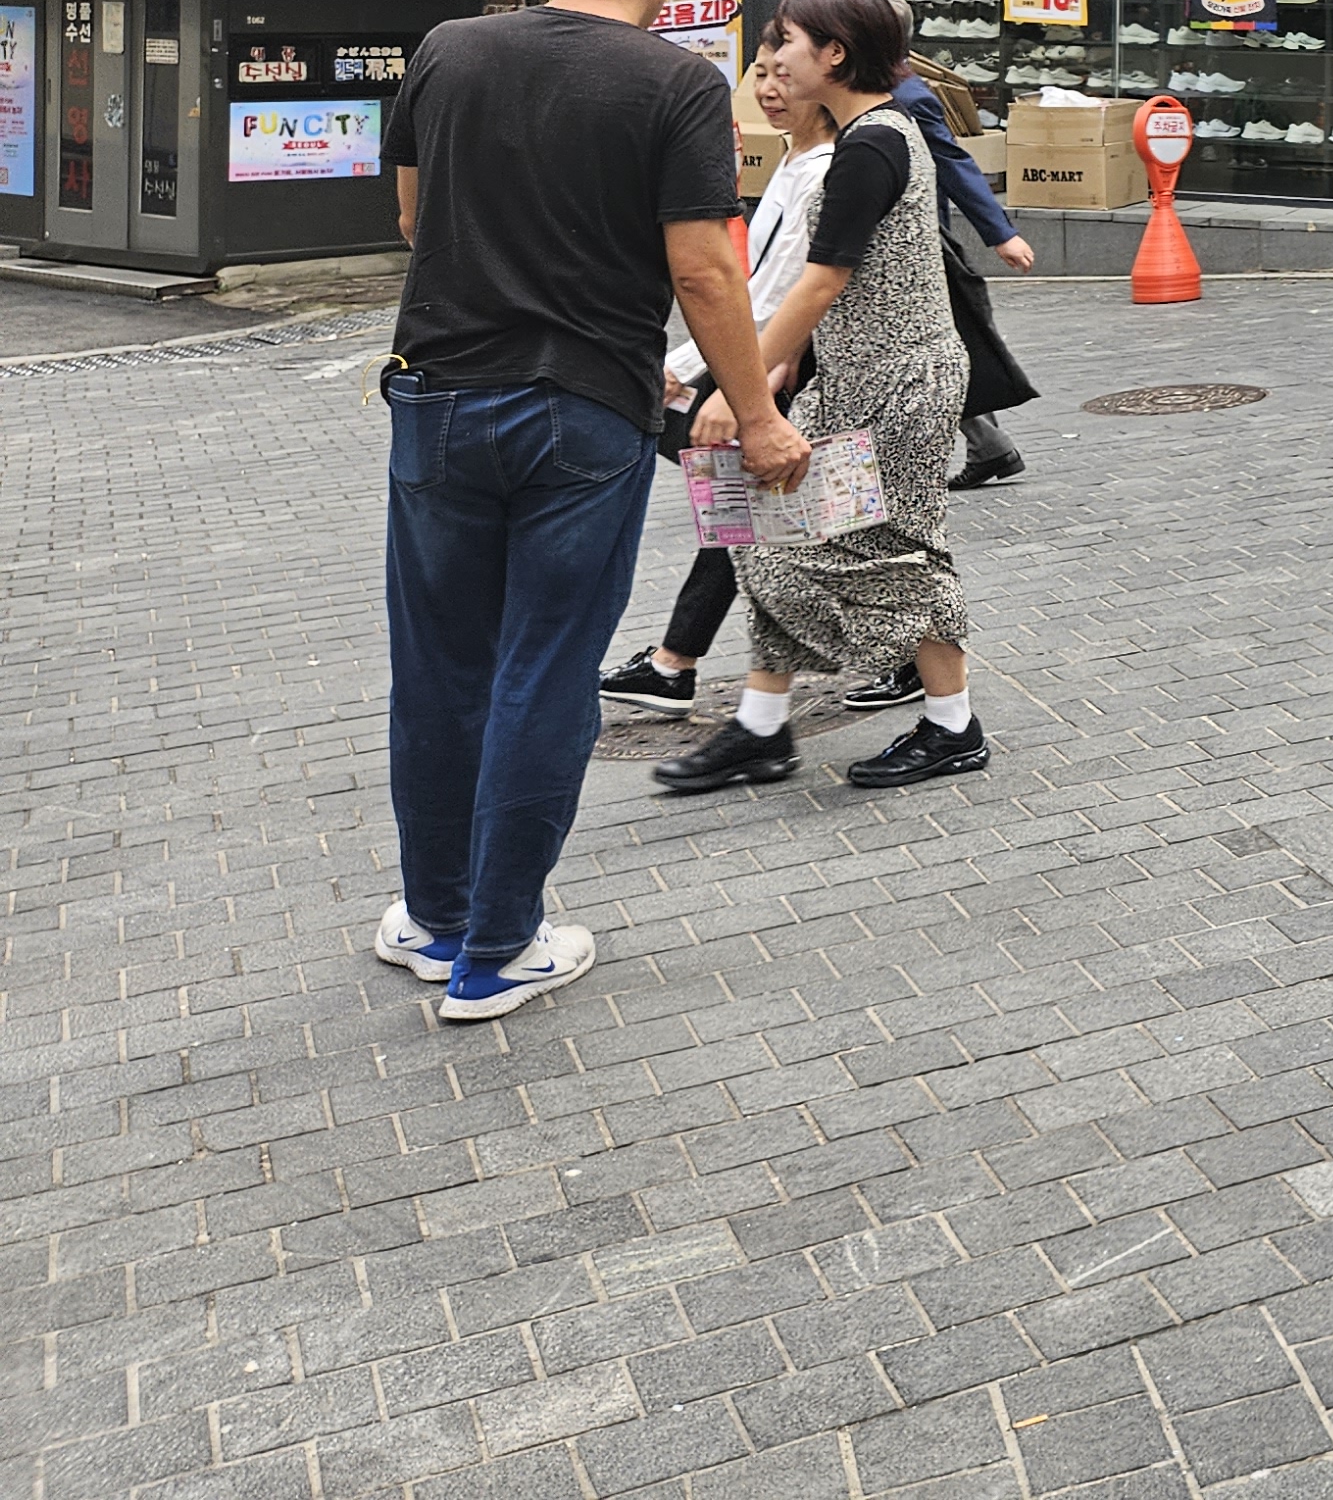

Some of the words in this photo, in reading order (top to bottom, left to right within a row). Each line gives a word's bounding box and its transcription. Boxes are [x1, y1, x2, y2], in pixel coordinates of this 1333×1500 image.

[243, 111, 298, 138] FUN
[303, 111, 370, 137] CITY
[1153, 120, 1186, 133] 주차금지
[1022, 168, 1084, 183] ABC-MART
